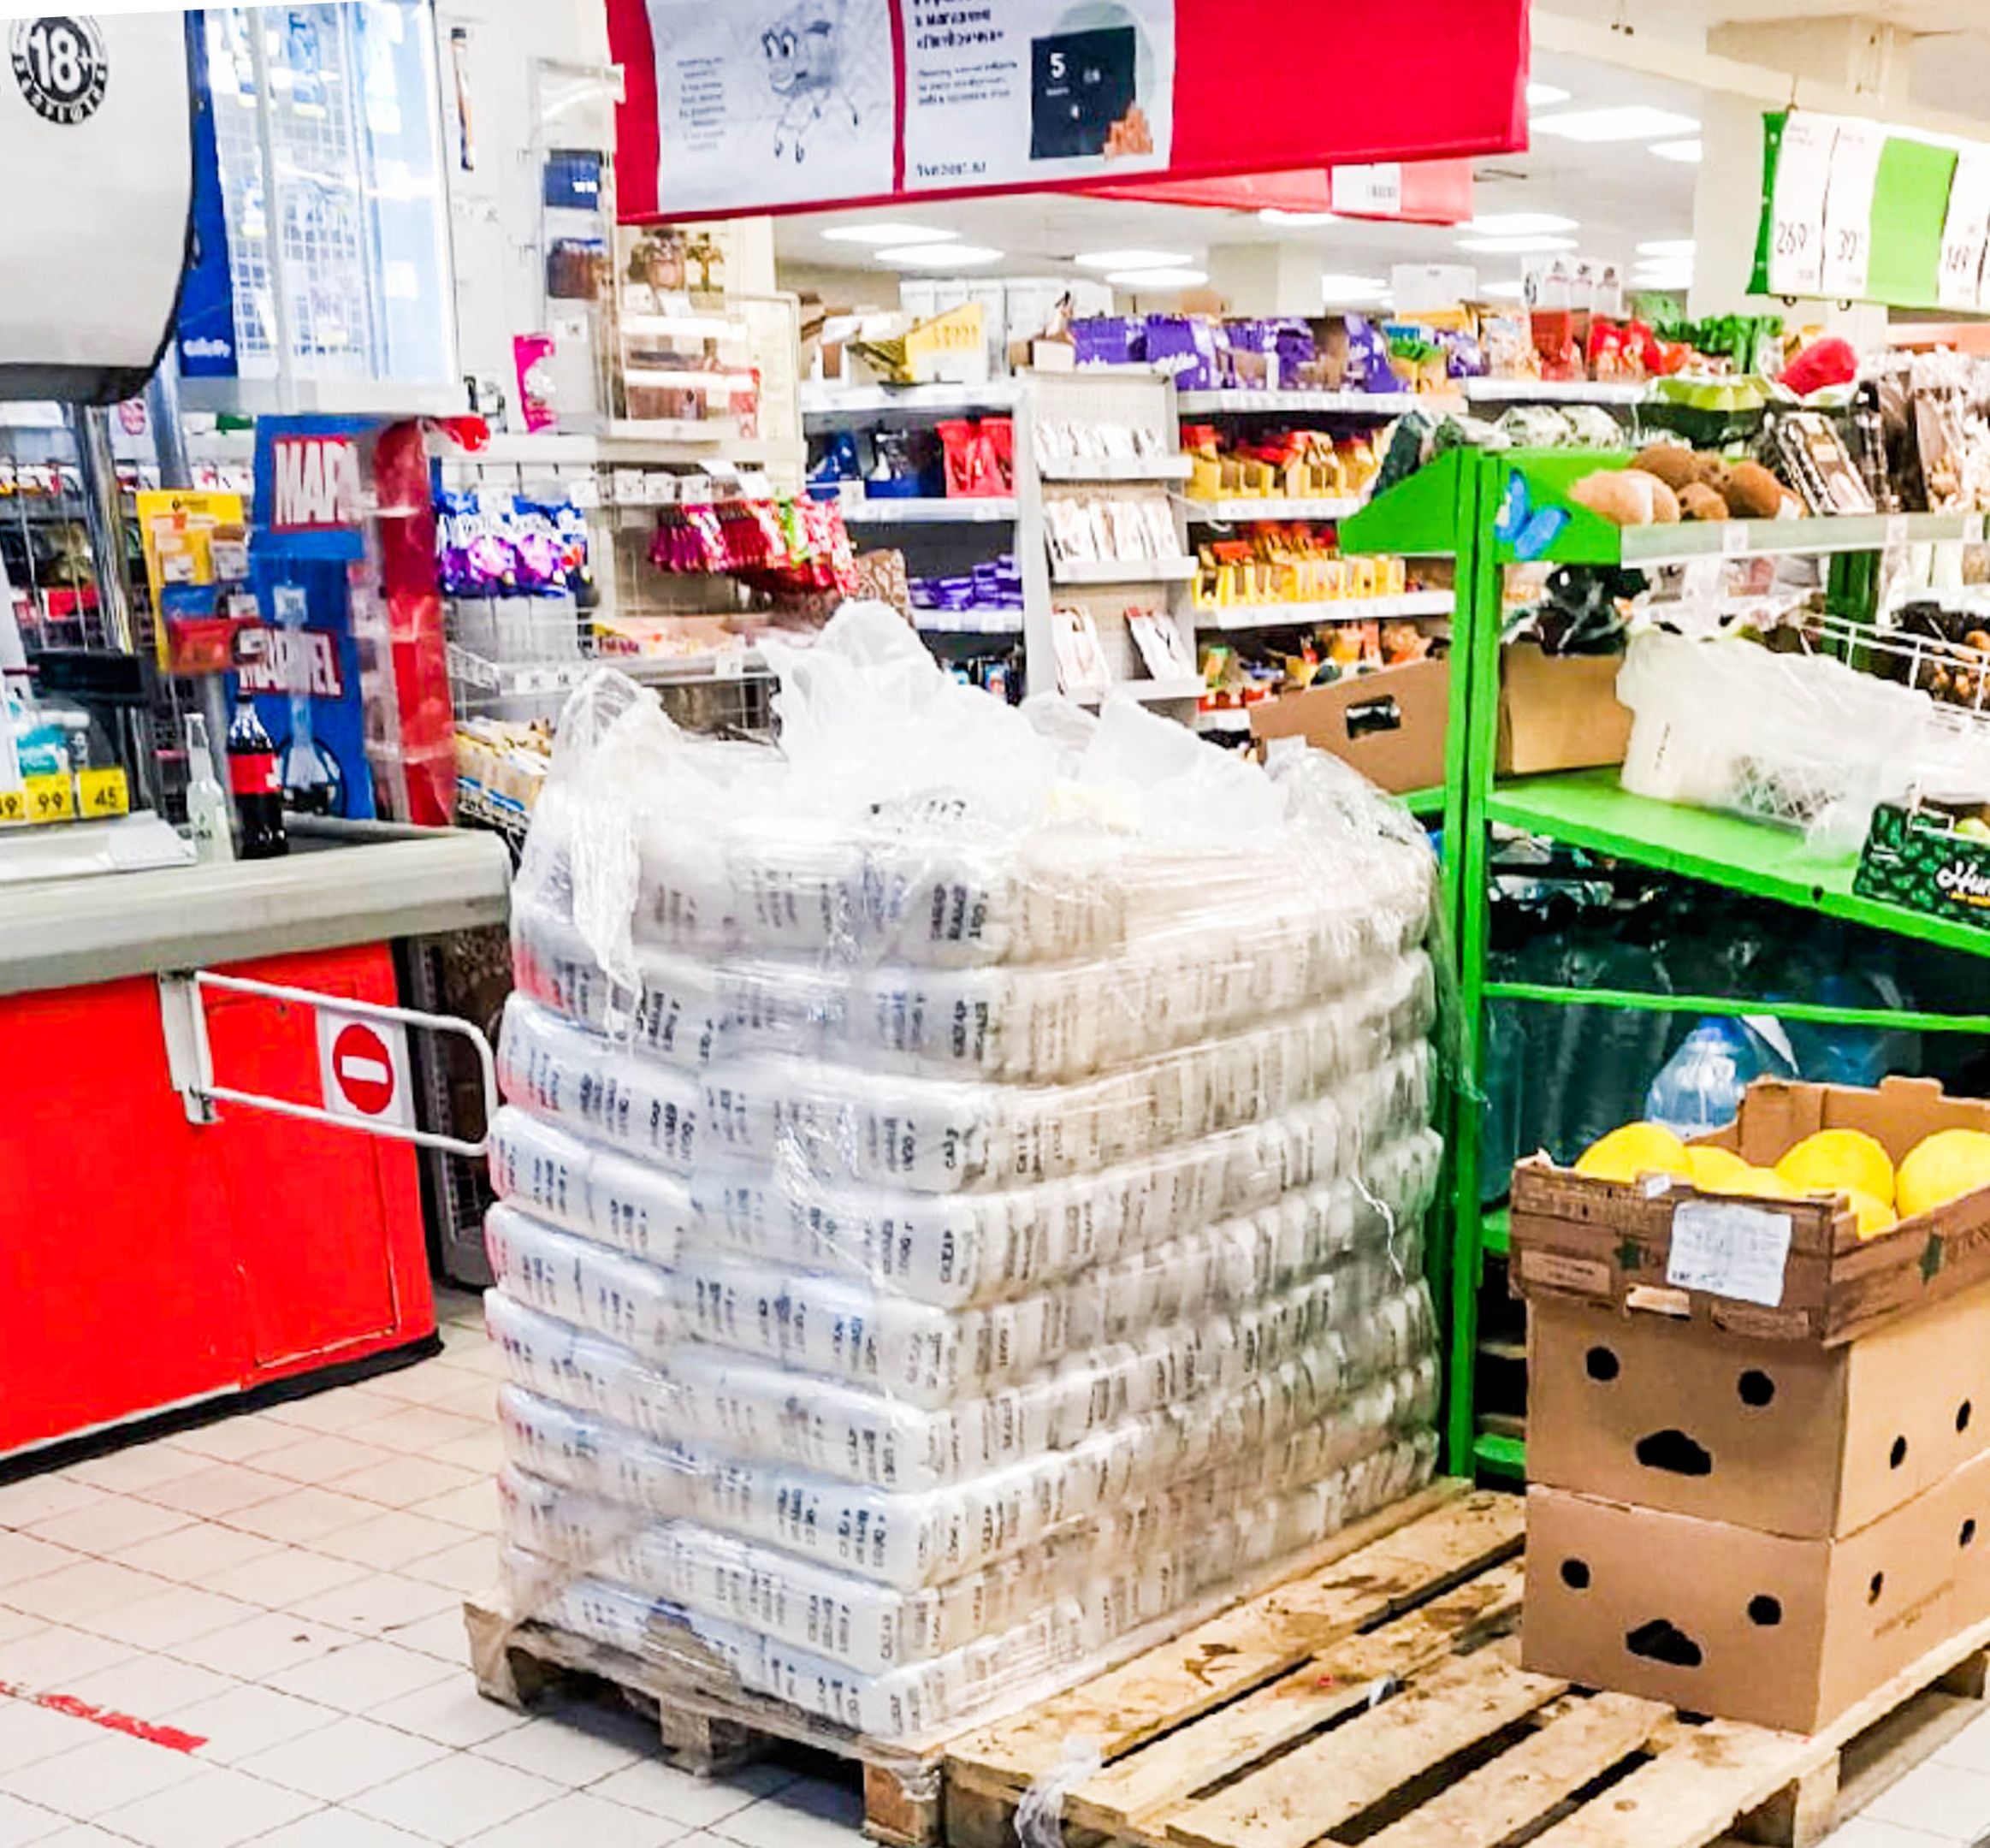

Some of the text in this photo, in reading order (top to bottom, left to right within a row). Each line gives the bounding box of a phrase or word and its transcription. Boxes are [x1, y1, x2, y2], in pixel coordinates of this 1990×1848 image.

[1050, 52, 1066, 79] 5
[38, 791, 64, 814] 99
[93, 785, 118, 808] 45
